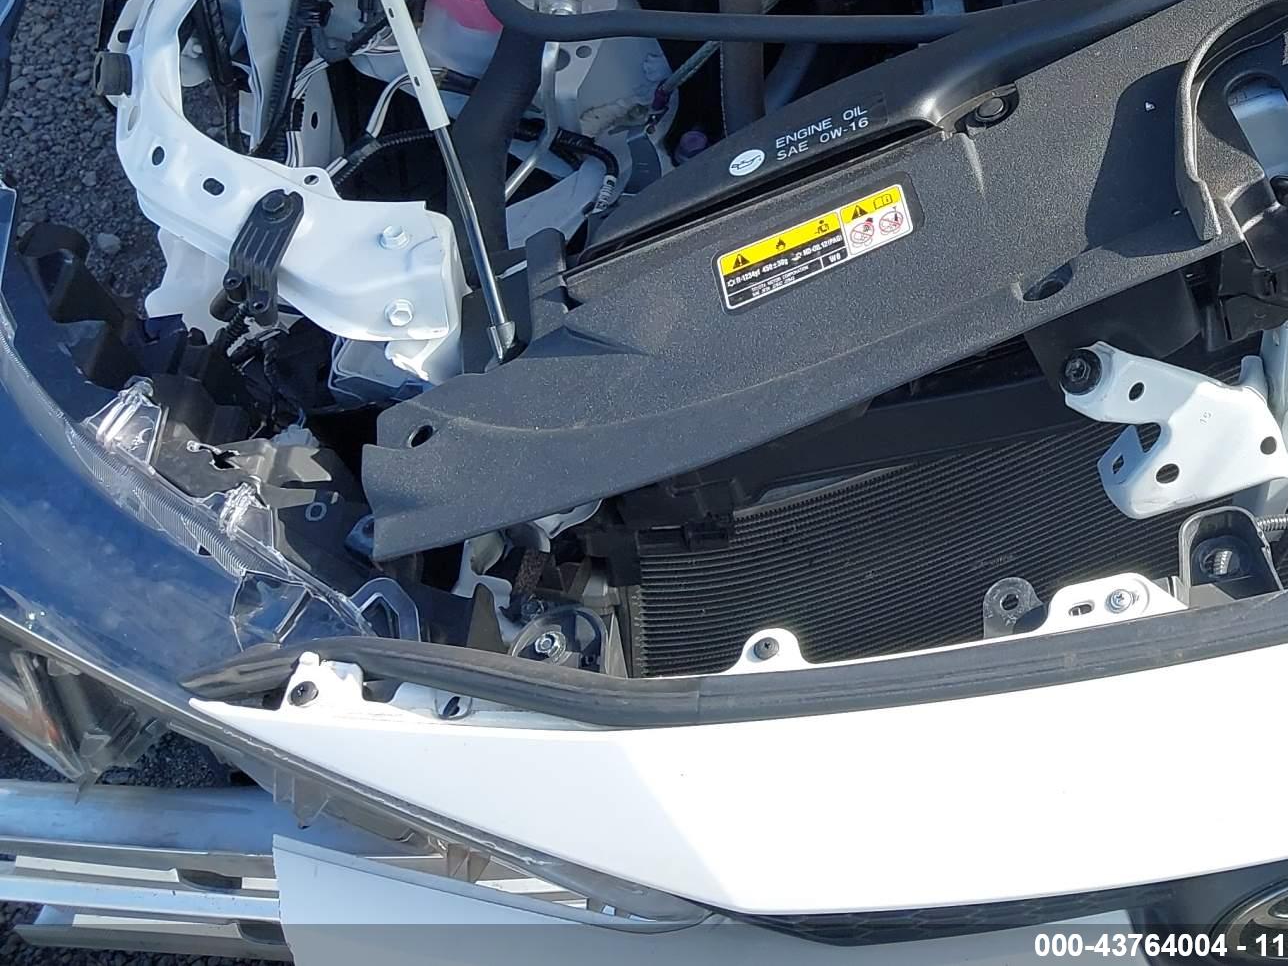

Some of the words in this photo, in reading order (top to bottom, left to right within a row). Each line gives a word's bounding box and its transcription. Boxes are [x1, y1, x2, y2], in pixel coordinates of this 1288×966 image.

[776, 117, 832, 149] ENGINE
[842, 106, 868, 121] OIL
[777, 140, 809, 161] SAE
[819, 117, 869, 143] 0W-16
